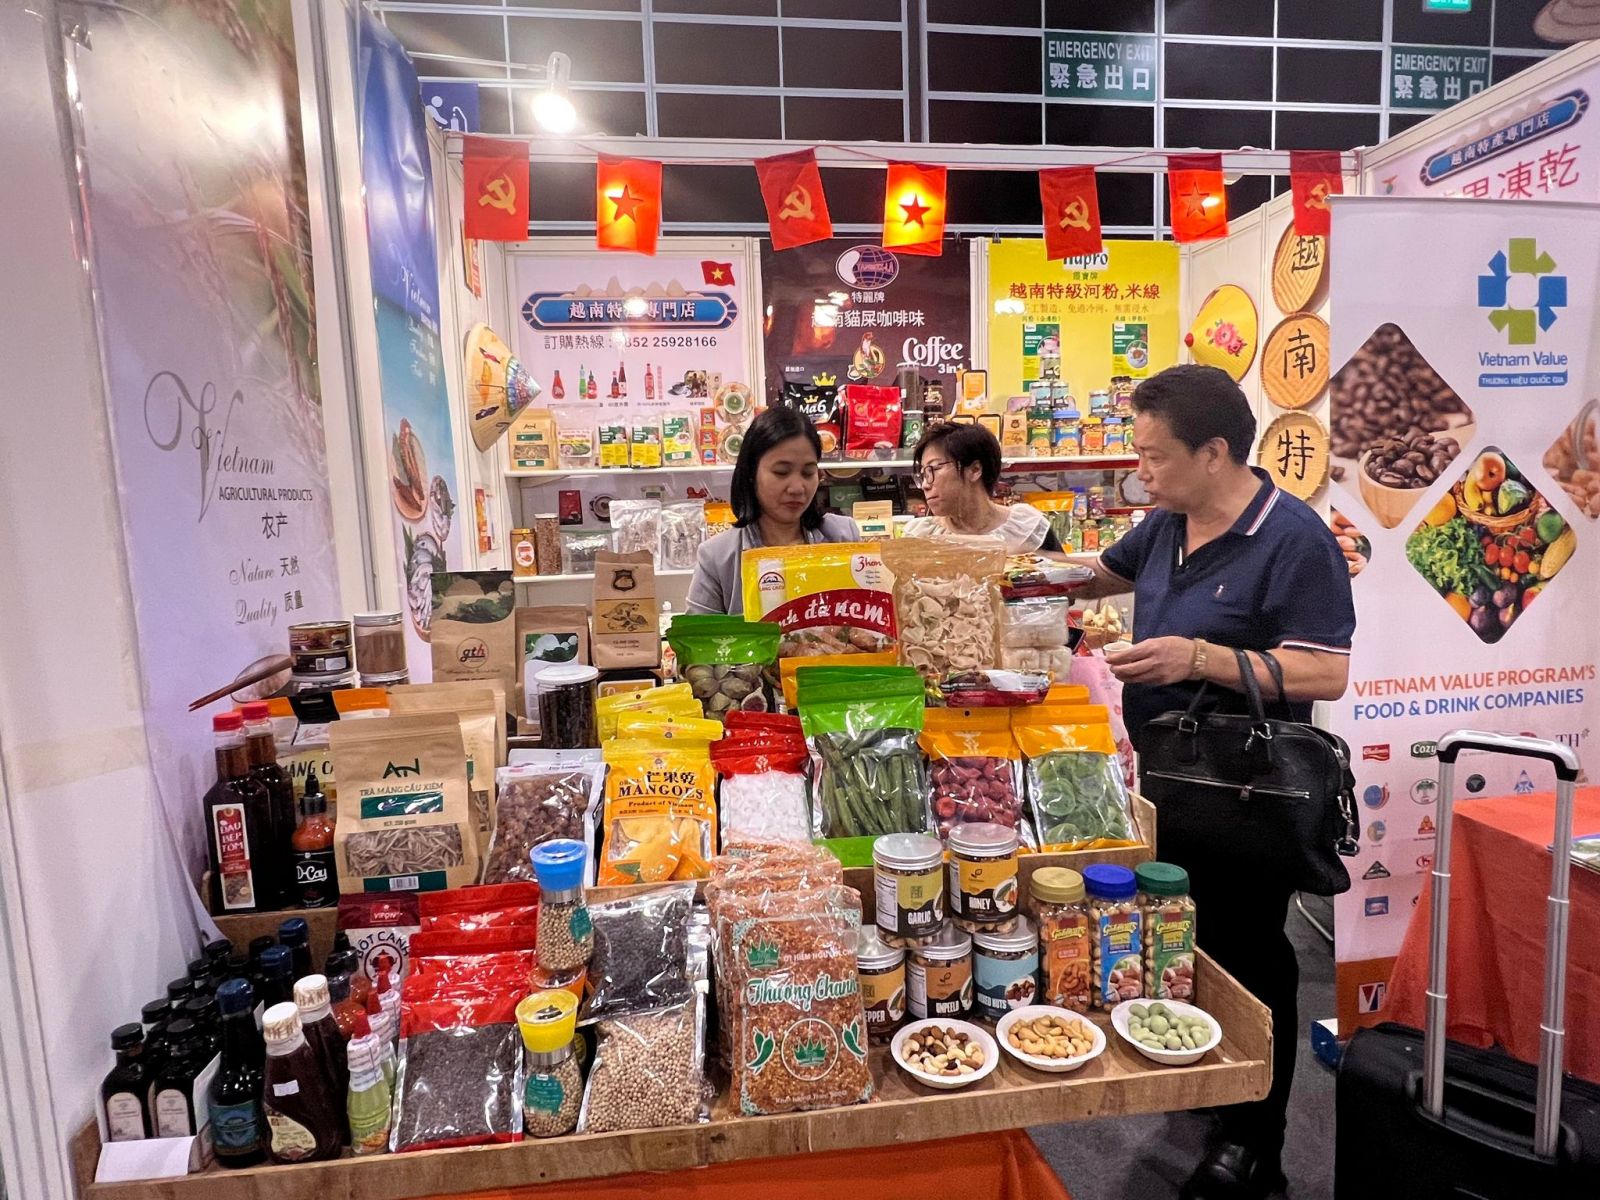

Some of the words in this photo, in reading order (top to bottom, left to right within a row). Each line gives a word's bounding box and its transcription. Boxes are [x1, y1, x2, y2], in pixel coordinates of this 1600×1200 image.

[1048, 40, 1122, 61] EMERGENCY
[1126, 43, 1151, 62] EXIT
[1394, 53, 1460, 74] EMERGENCY
[1463, 57, 1487, 75] EXIT
[1049, 62, 1151, 91] 緊急出口
[1394, 75, 1485, 100] 緊急出口
[1291, 235, 1320, 274] 越
[569, 301, 696, 319] 越南特專門店
[811, 310, 925, 328] 南貓屎咖啡味
[653, 336, 718, 348] 25928166
[902, 335, 964, 368] Coffee
[1283, 328, 1316, 379] 南
[1478, 351, 1530, 367] Vietnam
[1533, 350, 1568, 366] Value
[1277, 429, 1315, 480] 特
[219, 486, 277, 501] AGRICULTURAL
[278, 487, 313, 501] PRODUCTS
[261, 512, 288, 539] 农产
[229, 559, 275, 586] Nature
[234, 599, 278, 626] Quality
[1353, 675, 1436, 697] VIETNAM
[1440, 671, 1494, 691] VALUE
[1497, 664, 1596, 687] PROGRAM'S
[1353, 701, 1405, 721] FOOD
[1408, 700, 1421, 716] &
[1425, 695, 1480, 716] DRINK
[1483, 688, 1584, 710] COMPANIES
[1555, 732, 1580, 748] TH
[618, 784, 704, 800] MANGOES
[968, 898, 991, 910] HONEY
[907, 911, 932, 925] GARLIC
